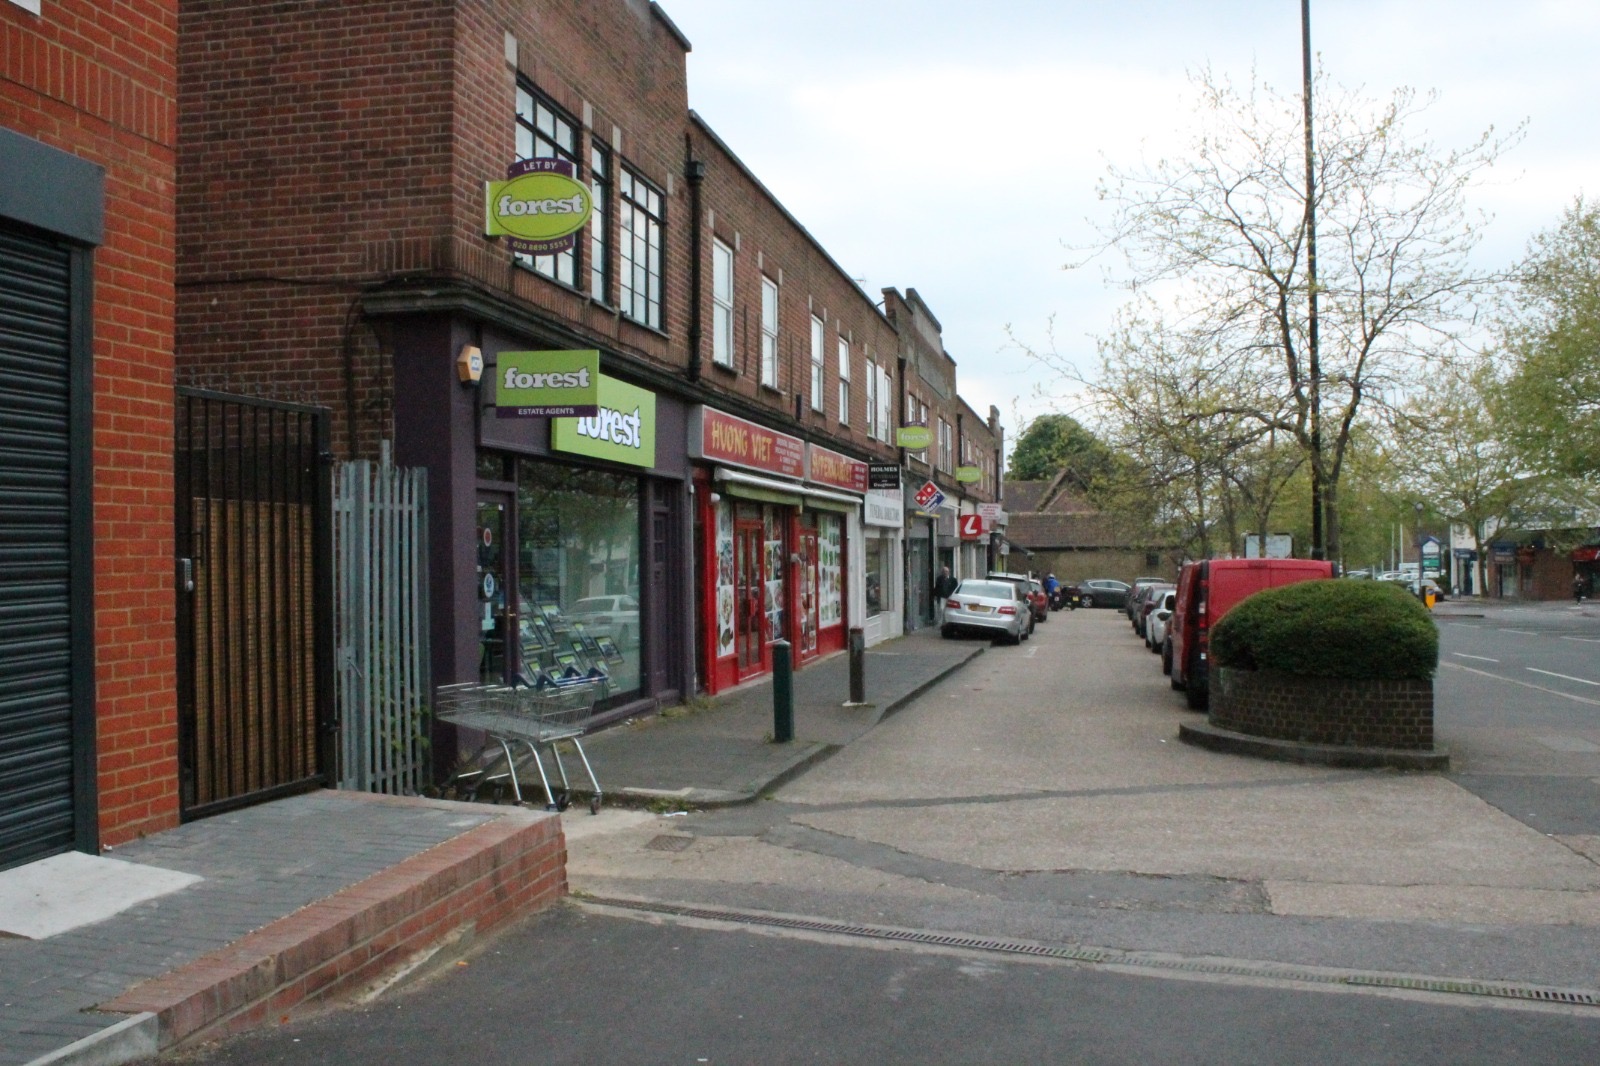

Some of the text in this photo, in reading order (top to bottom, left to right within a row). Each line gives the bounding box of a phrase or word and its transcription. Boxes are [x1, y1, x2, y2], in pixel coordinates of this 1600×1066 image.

[523, 161, 557, 171] LET BY
[498, 193, 583, 217] forest
[512, 241, 527, 250] 020
[504, 366, 590, 389] forest
[518, 407, 575, 415] ESTATE AGENTS
